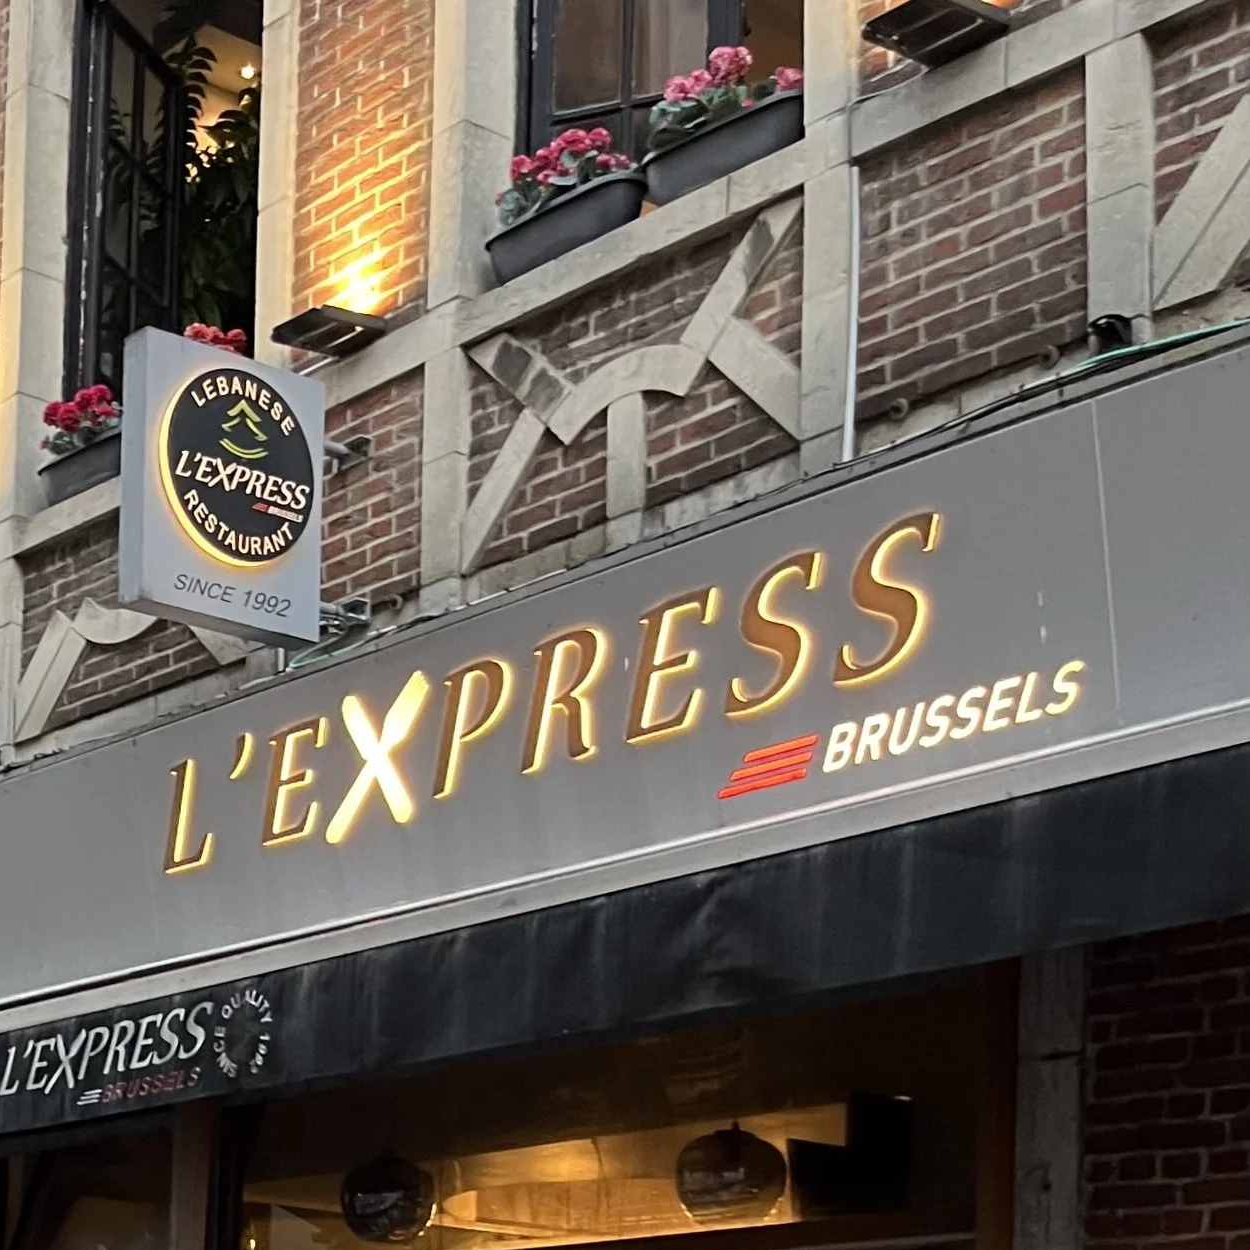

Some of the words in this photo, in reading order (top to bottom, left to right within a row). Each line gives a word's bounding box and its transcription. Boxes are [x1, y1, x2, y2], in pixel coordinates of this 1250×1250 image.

[191, 375, 296, 437] LEBANESE
[175, 449, 310, 511] L'EXPRESS
[183, 488, 295, 556] RESTAURANT
[173, 573, 236, 604] SINCE
[243, 590, 291, 618] 1992
[161, 510, 943, 876] L'EXPRESS
[821, 659, 1088, 774] BRUSSELS
[101, 1067, 201, 1102] BRUSSELS
